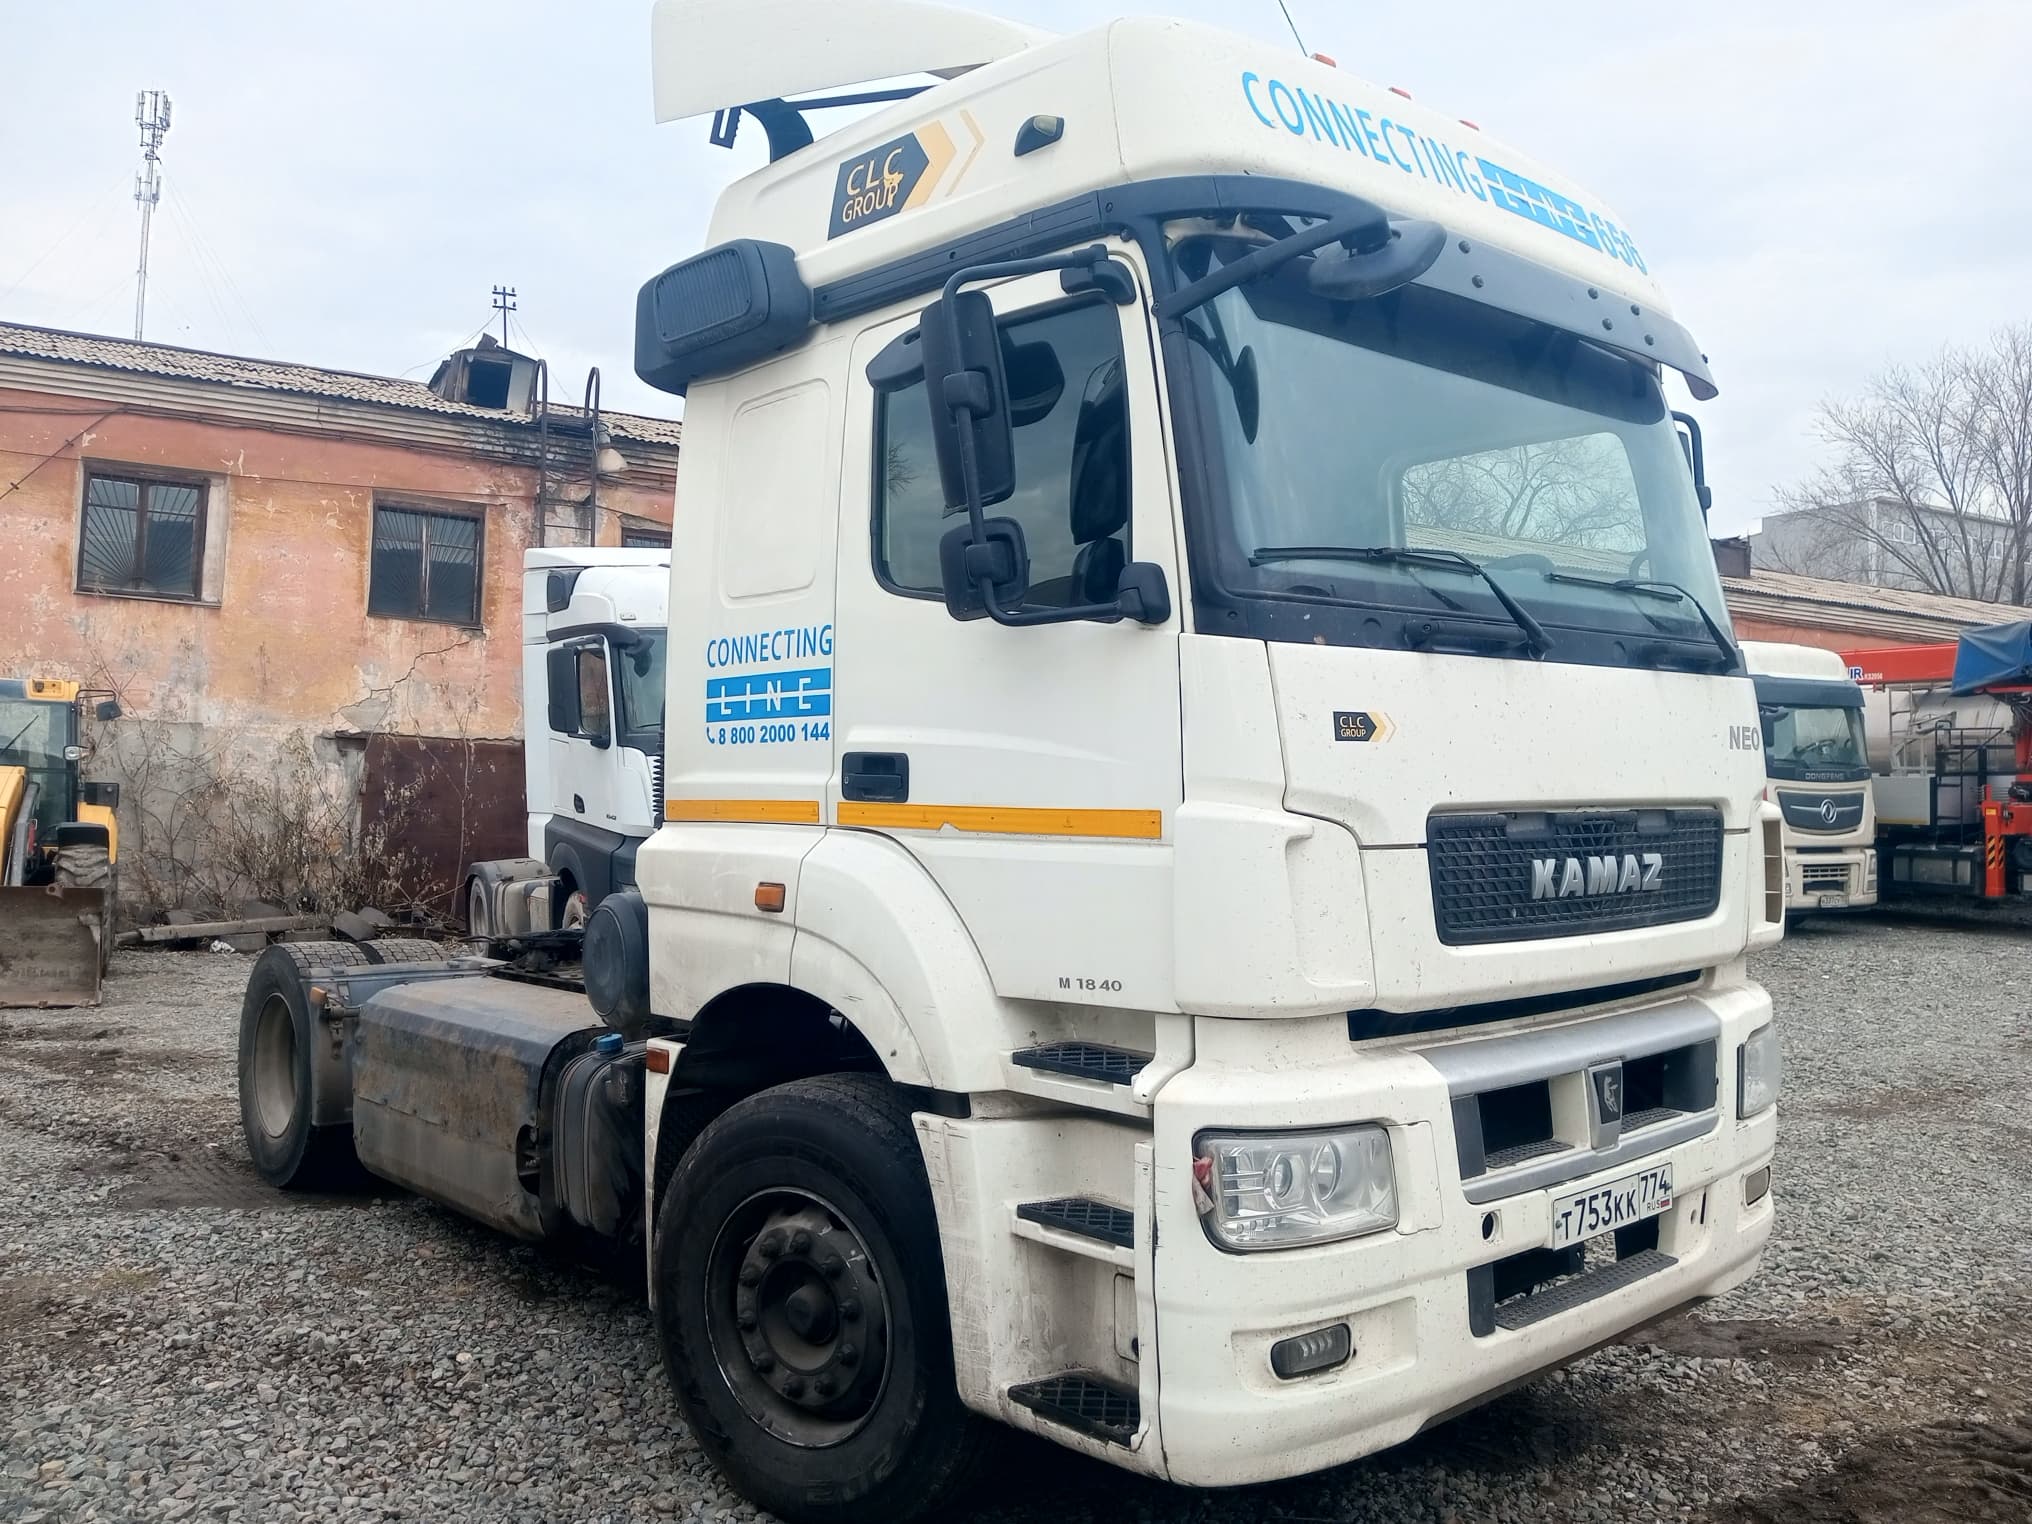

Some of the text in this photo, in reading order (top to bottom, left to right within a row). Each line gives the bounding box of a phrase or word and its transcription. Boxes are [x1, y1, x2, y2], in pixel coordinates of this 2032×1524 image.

[1241, 71, 1488, 202] CONNECTING
[1495, 171, 1587, 240] LINE
[845, 146, 905, 196] CLC
[841, 182, 899, 224] GROUP
[706, 624, 833, 668] CONNECTING
[1848, 667, 1863, 680] IR
[720, 677, 812, 715] LINE
[718, 721, 830, 745] 8 800 2000 144
[1339, 716, 1365, 728] CLC
[1340, 728, 1366, 737] GROUP
[1729, 725, 1760, 751] NEO
[1531, 853, 1663, 900] KAMAZ
[1058, 977, 1122, 992] M 1840
[1640, 1169, 1671, 1203] 774
[1647, 1201, 1660, 1213] RUS
